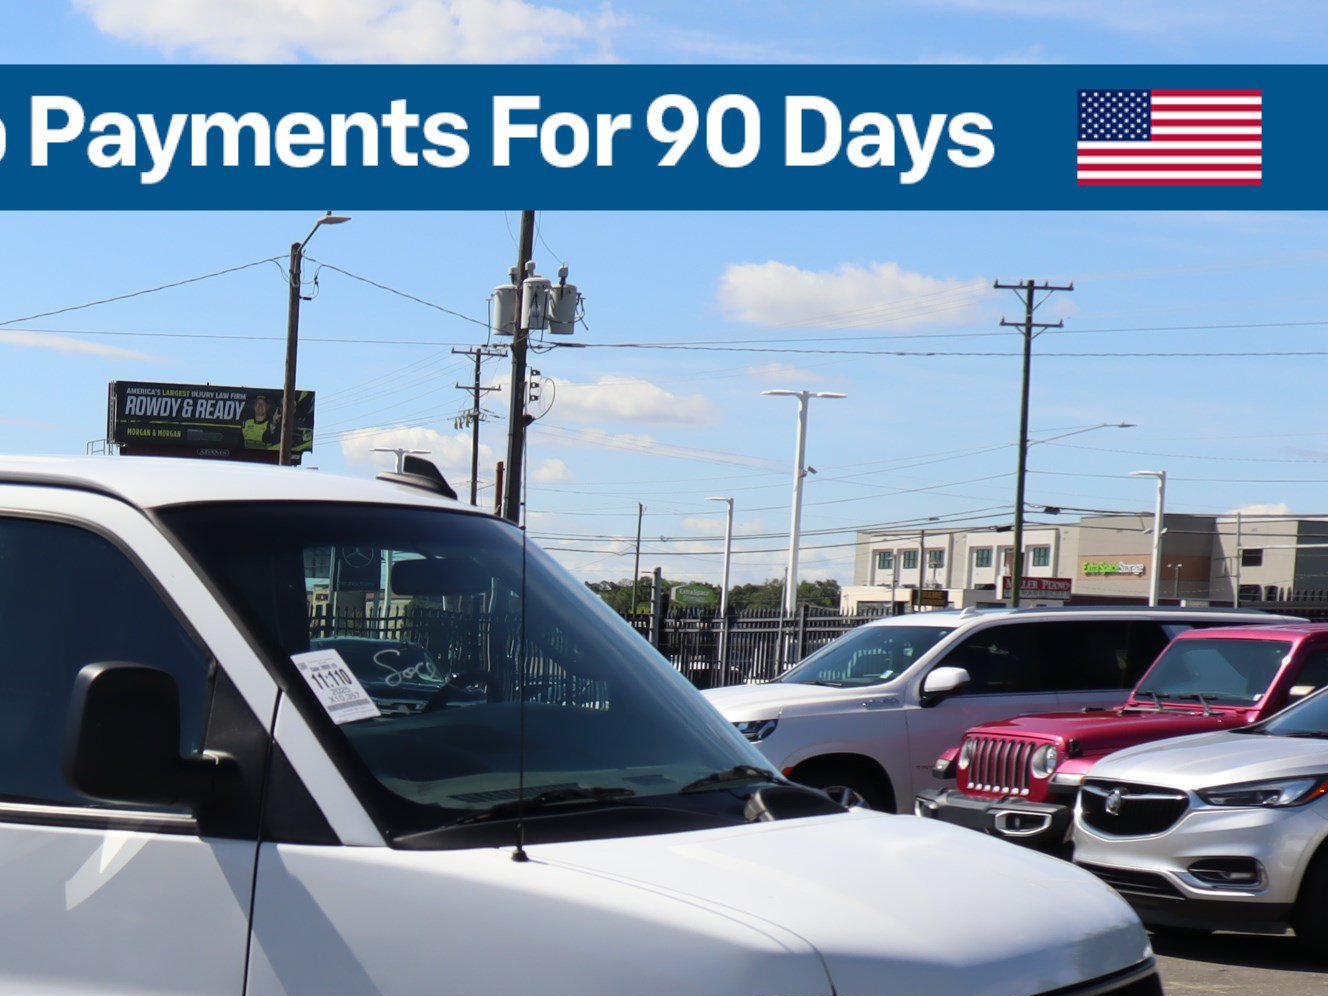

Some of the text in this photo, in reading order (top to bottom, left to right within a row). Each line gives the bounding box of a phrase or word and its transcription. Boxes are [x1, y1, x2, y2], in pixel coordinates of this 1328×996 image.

[126, 387, 247, 400] AMERICA'S LARGEST INJURY LAW FIRM
[125, 395, 246, 420] ROWDY & READY
[127, 427, 151, 437] MORGAN
[157, 429, 182, 438] MORGAN
